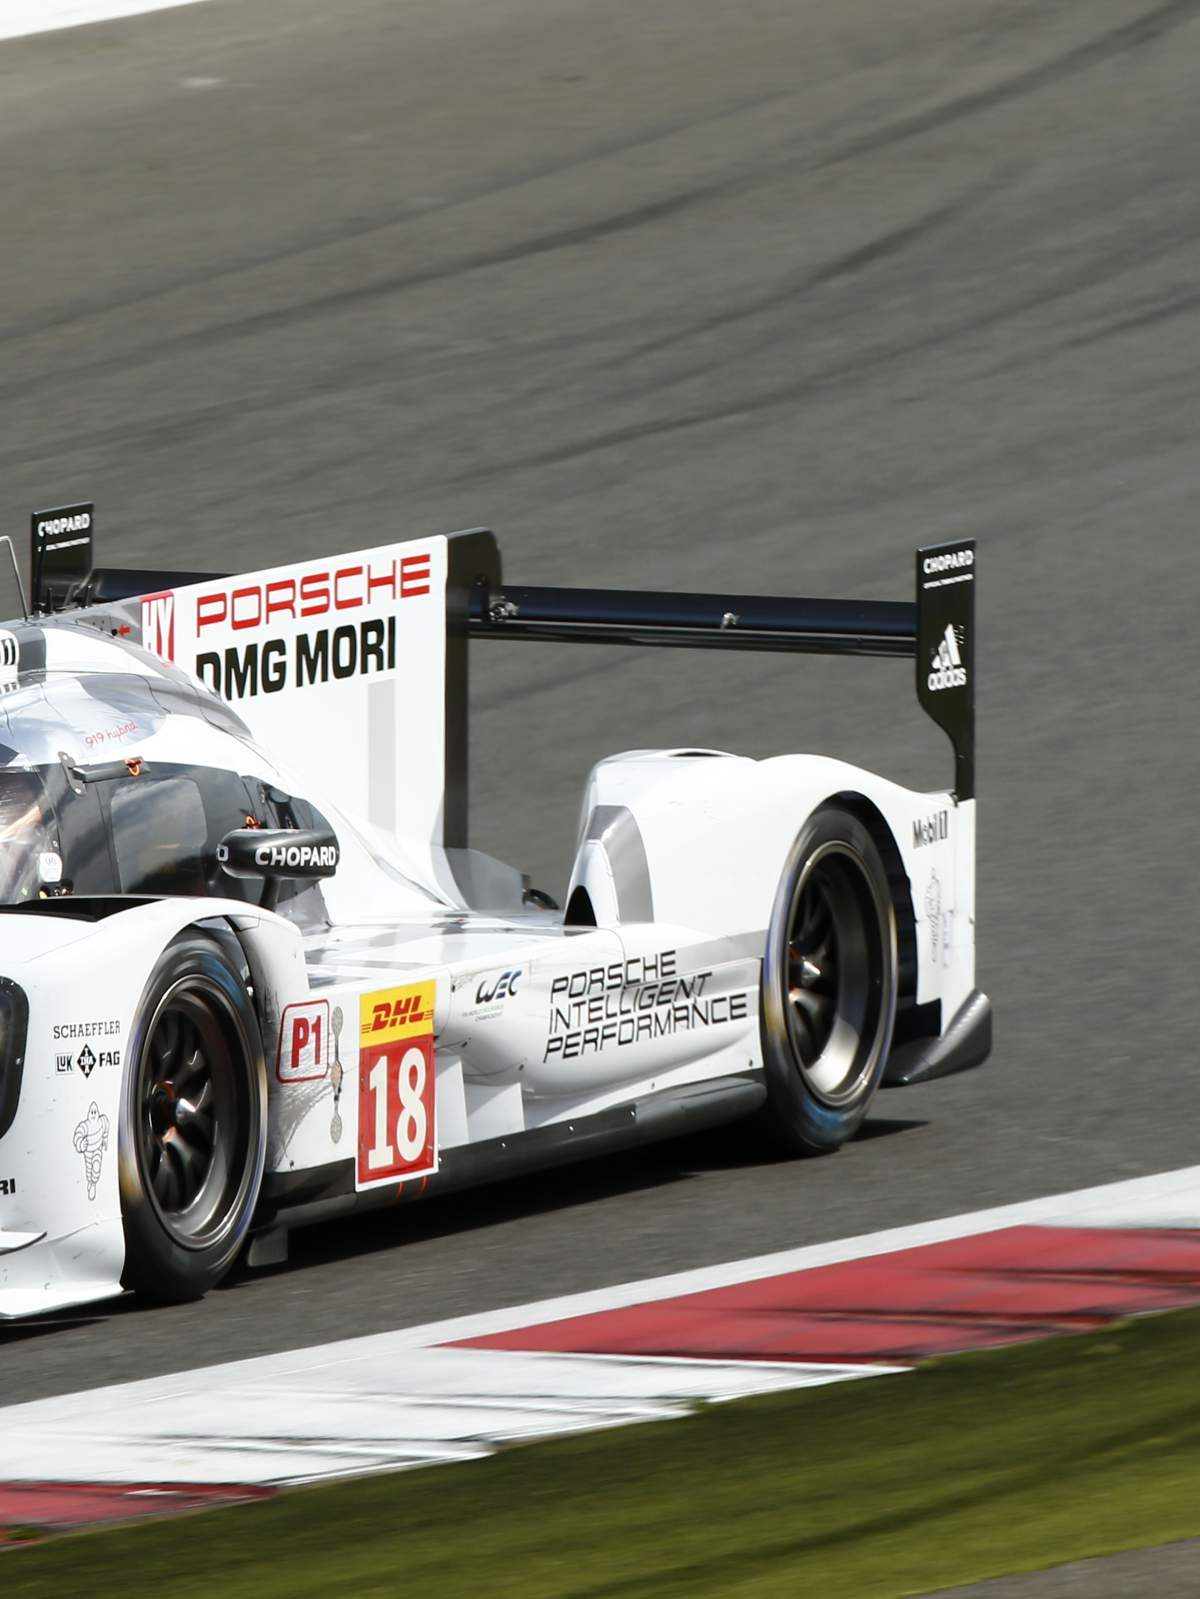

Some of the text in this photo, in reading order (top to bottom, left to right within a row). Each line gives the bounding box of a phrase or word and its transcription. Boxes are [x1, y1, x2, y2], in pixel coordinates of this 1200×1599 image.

[923, 550, 973, 574] CHOPARD
[196, 553, 431, 638] PORSCHE
[141, 596, 174, 662] HY
[196, 616, 396, 700] DMG MORI
[928, 667, 967, 691] adidas
[85, 732, 105, 748] 919
[255, 846, 336, 867] CHOPARD
[476, 969, 522, 1004] WEC
[551, 950, 676, 1004] PORSCHE
[371, 995, 426, 1031] DHL
[549, 972, 712, 1034] INTELLIGENT
[53, 1020, 121, 1039] SCHAEFFLER
[291, 1015, 322, 1068] P1
[543, 993, 748, 1063] PERFORMANCE
[99, 1051, 120, 1067] FAG
[368, 1047, 427, 1170] 18
